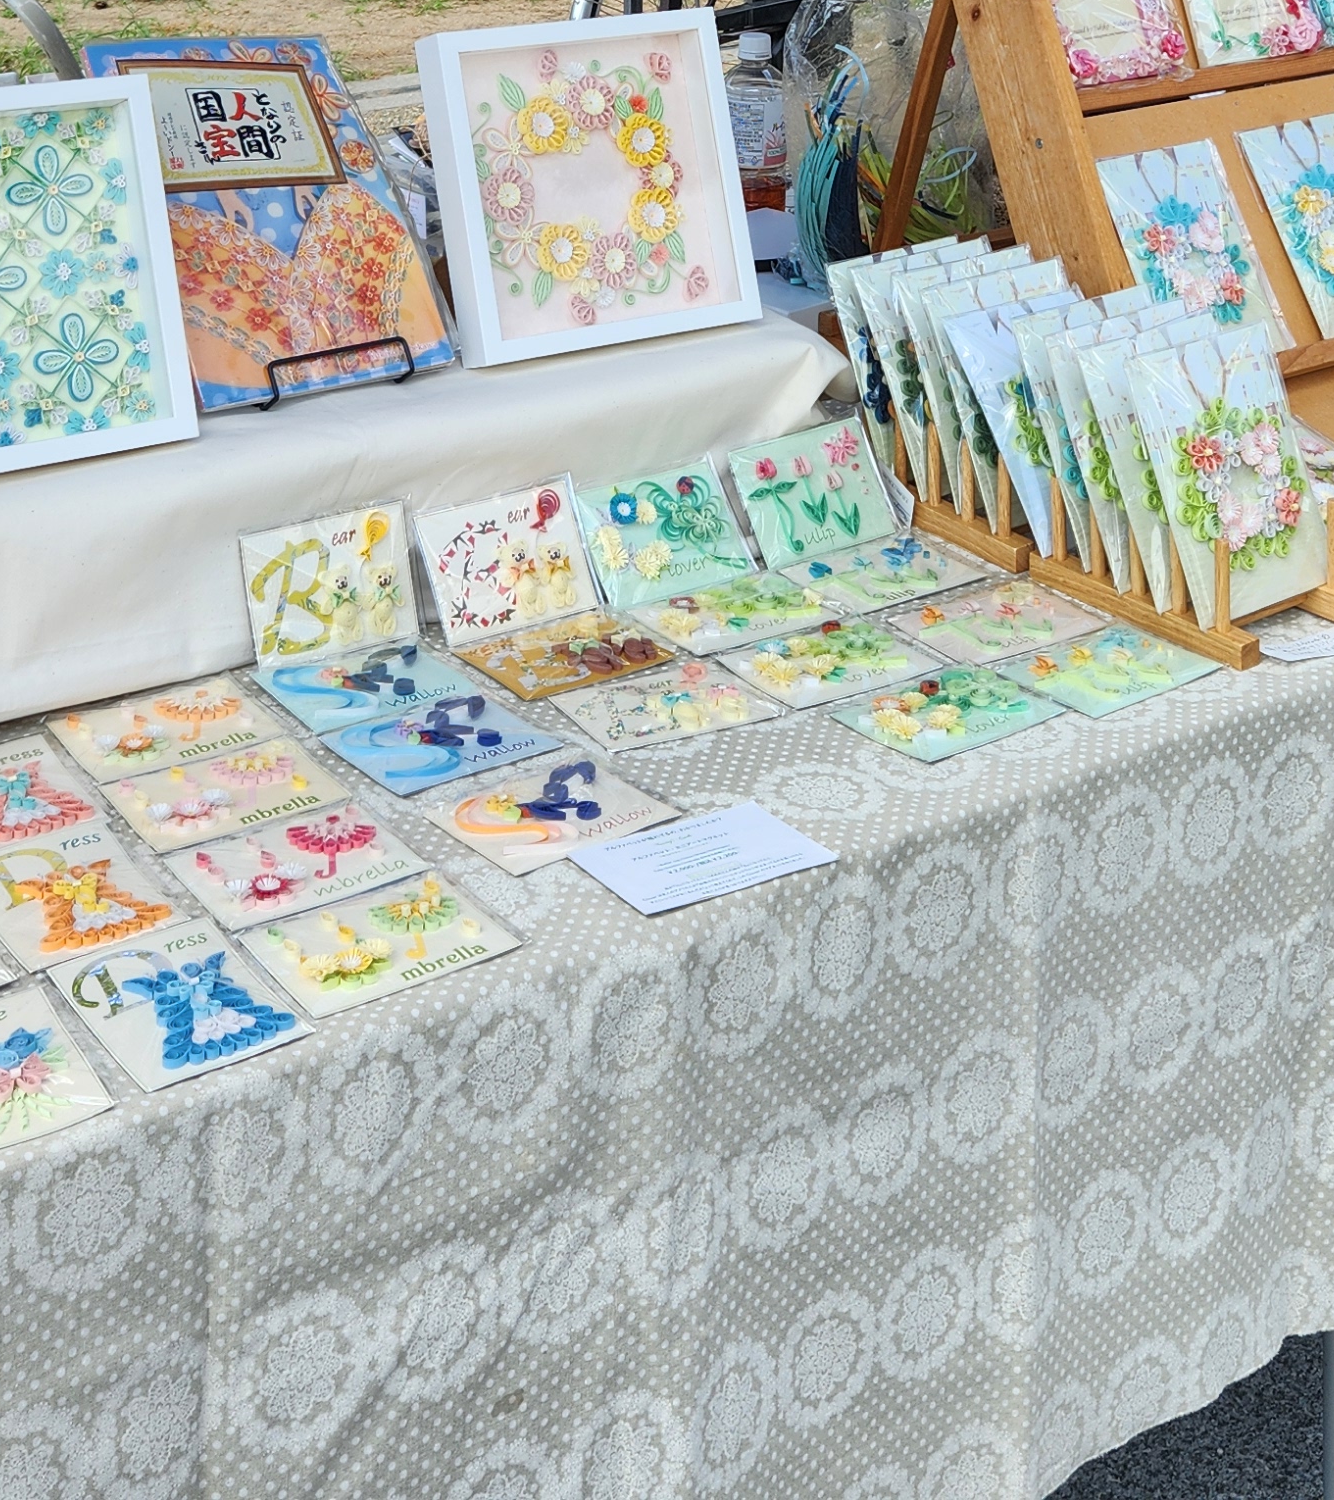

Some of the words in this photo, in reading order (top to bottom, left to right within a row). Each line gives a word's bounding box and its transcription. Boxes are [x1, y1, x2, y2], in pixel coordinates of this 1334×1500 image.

[252, 92, 287, 144] となりの
[331, 529, 357, 548] ear
[178, 729, 258, 759] mbrella
[464, 737, 537, 764] wallow
[239, 792, 322, 826] mbrella
[579, 805, 653, 838] wallow
[59, 831, 102, 851] ress
[313, 858, 409, 897] mbrella
[163, 930, 208, 952] ress
[399, 941, 488, 982] mbrella
